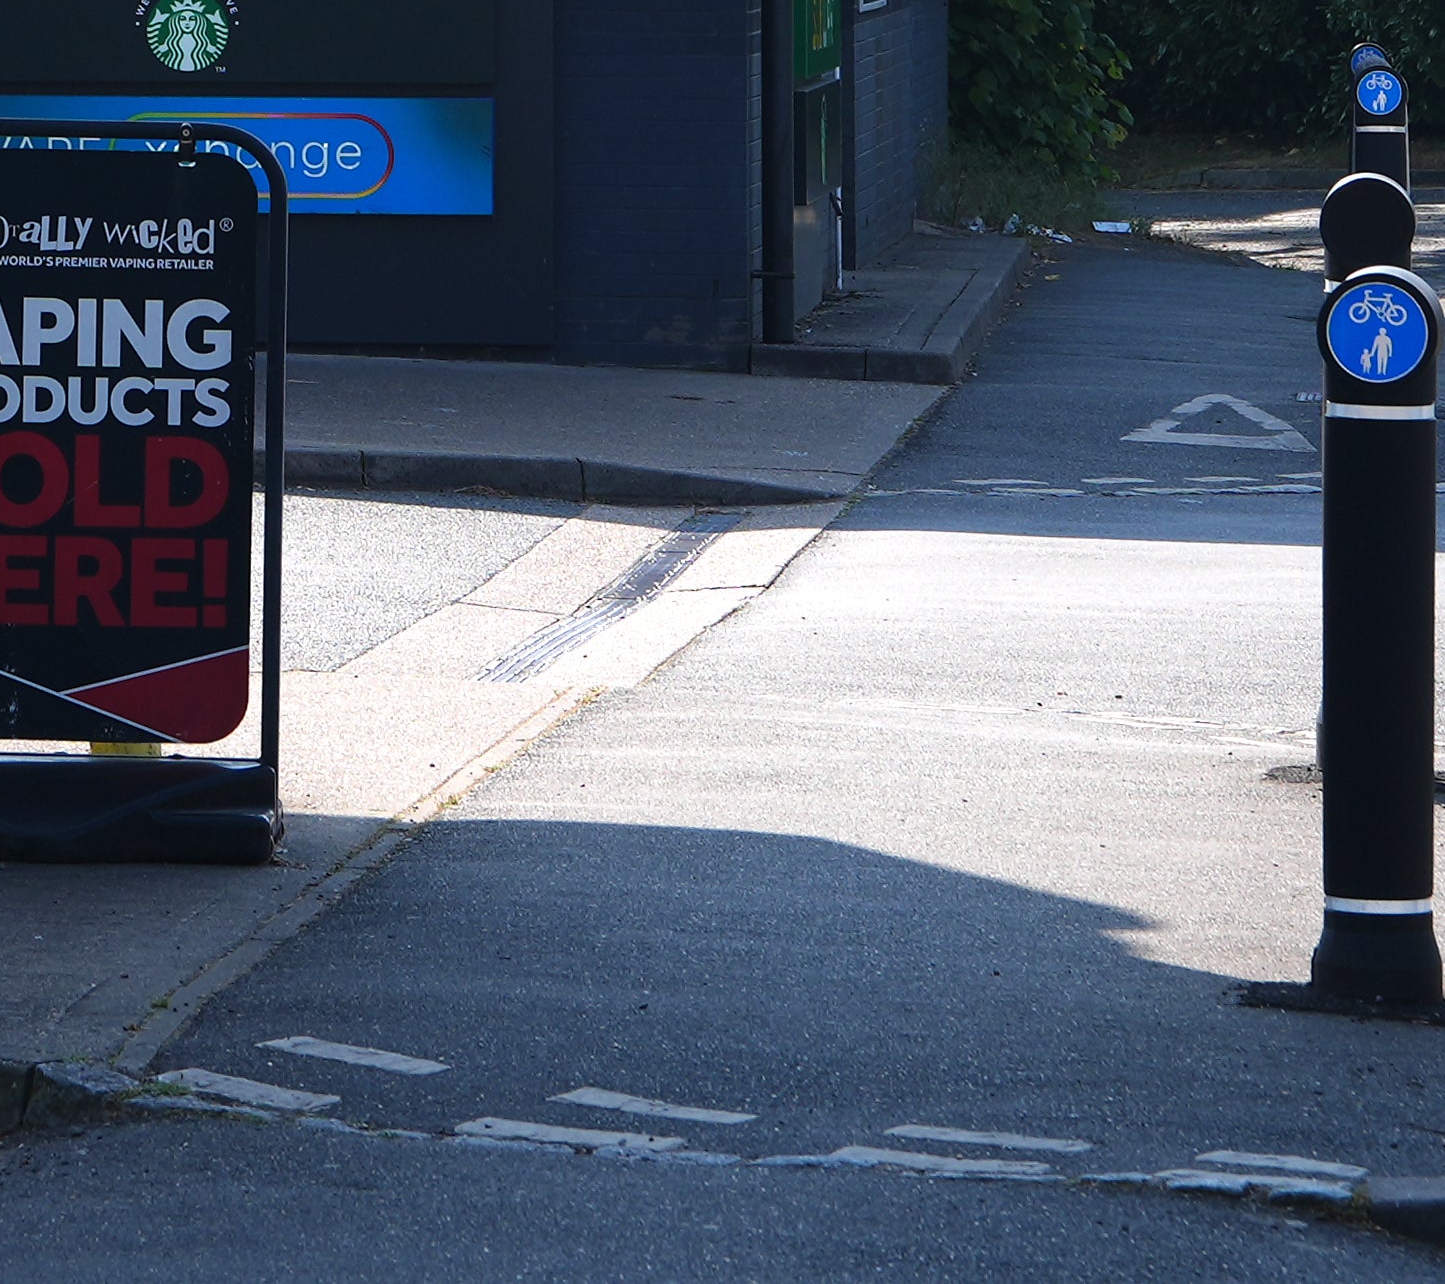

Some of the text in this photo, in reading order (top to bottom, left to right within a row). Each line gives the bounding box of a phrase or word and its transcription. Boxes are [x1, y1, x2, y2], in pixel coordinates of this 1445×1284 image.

[56, 256, 108, 269] PREMIER
[110, 256, 156, 269] VAPING
[157, 257, 215, 270] RETAILER
